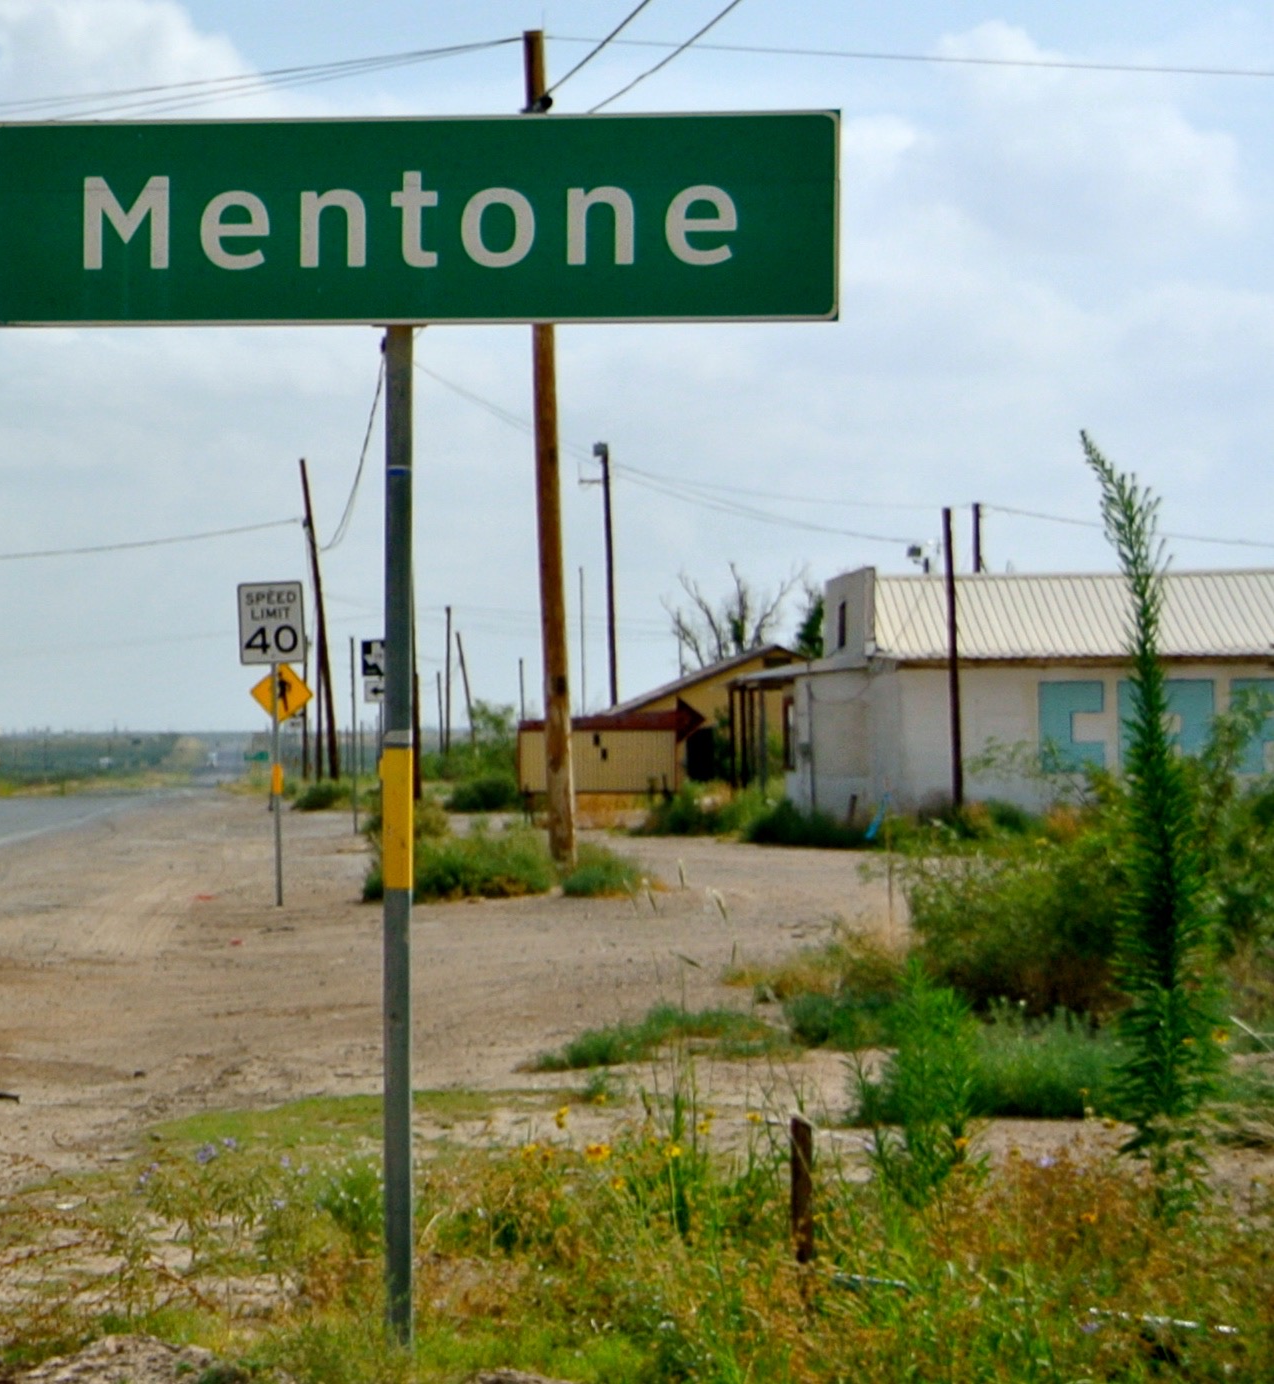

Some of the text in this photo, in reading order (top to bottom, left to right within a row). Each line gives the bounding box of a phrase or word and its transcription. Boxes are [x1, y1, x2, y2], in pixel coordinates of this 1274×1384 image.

[83, 170, 738, 270] Mentone
[245, 590, 297, 606] SPEED
[250, 607, 291, 621] LIMIT
[244, 625, 298, 655] 40
